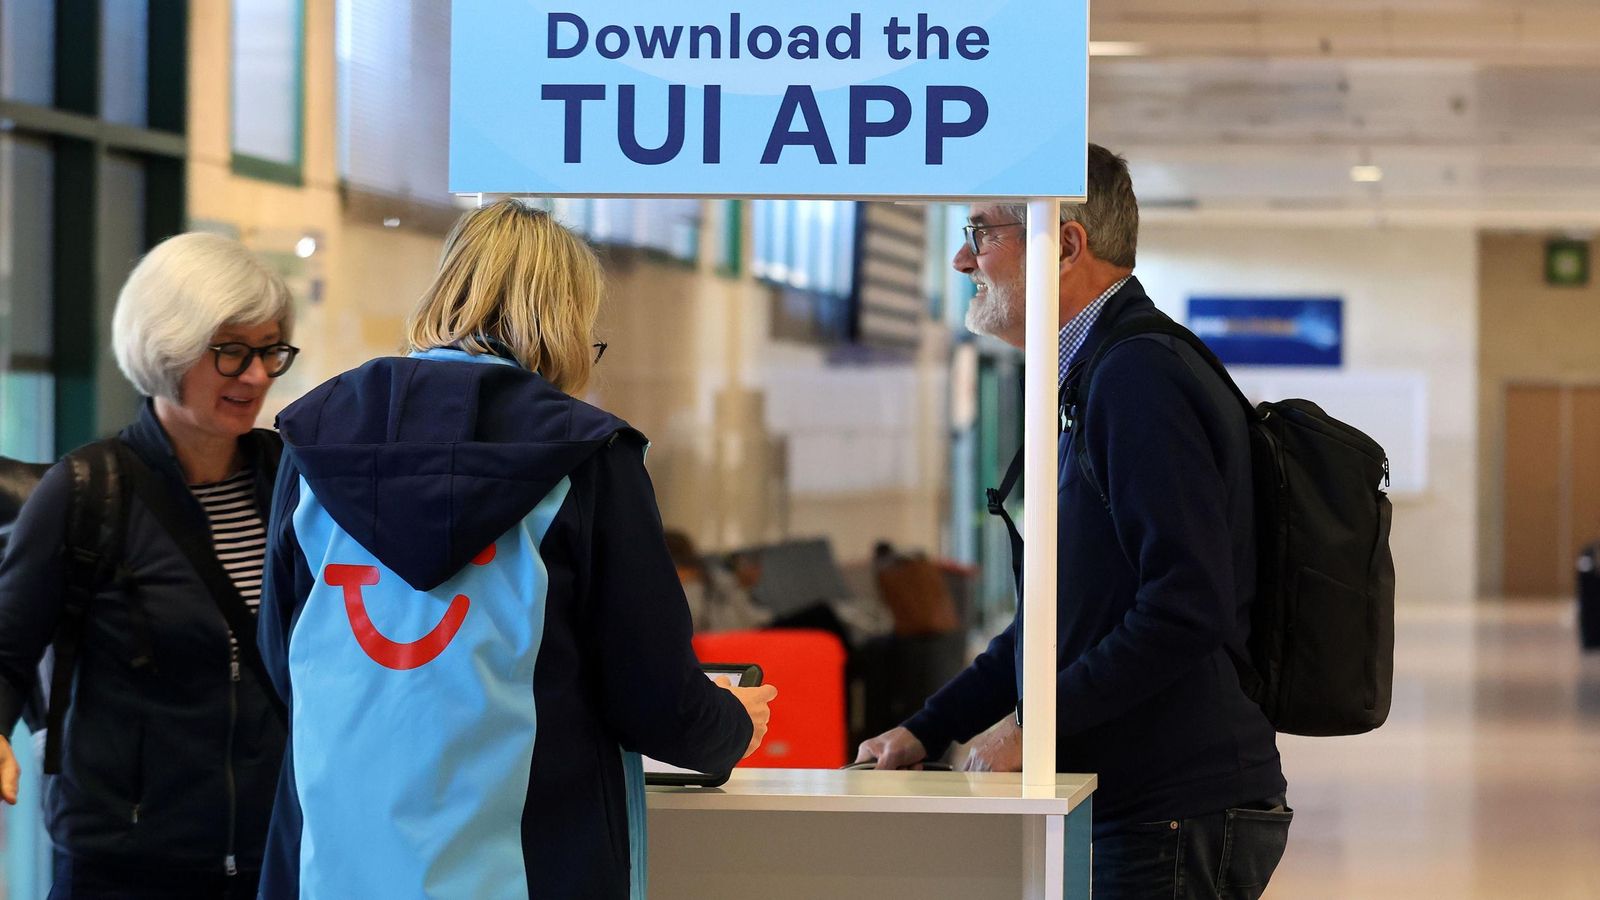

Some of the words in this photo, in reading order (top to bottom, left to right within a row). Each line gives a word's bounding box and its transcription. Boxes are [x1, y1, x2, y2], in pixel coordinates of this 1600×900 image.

[547, 12, 861, 61] Download
[883, 12, 991, 61] the
[541, 84, 721, 166] TUI
[759, 84, 990, 165] APP
